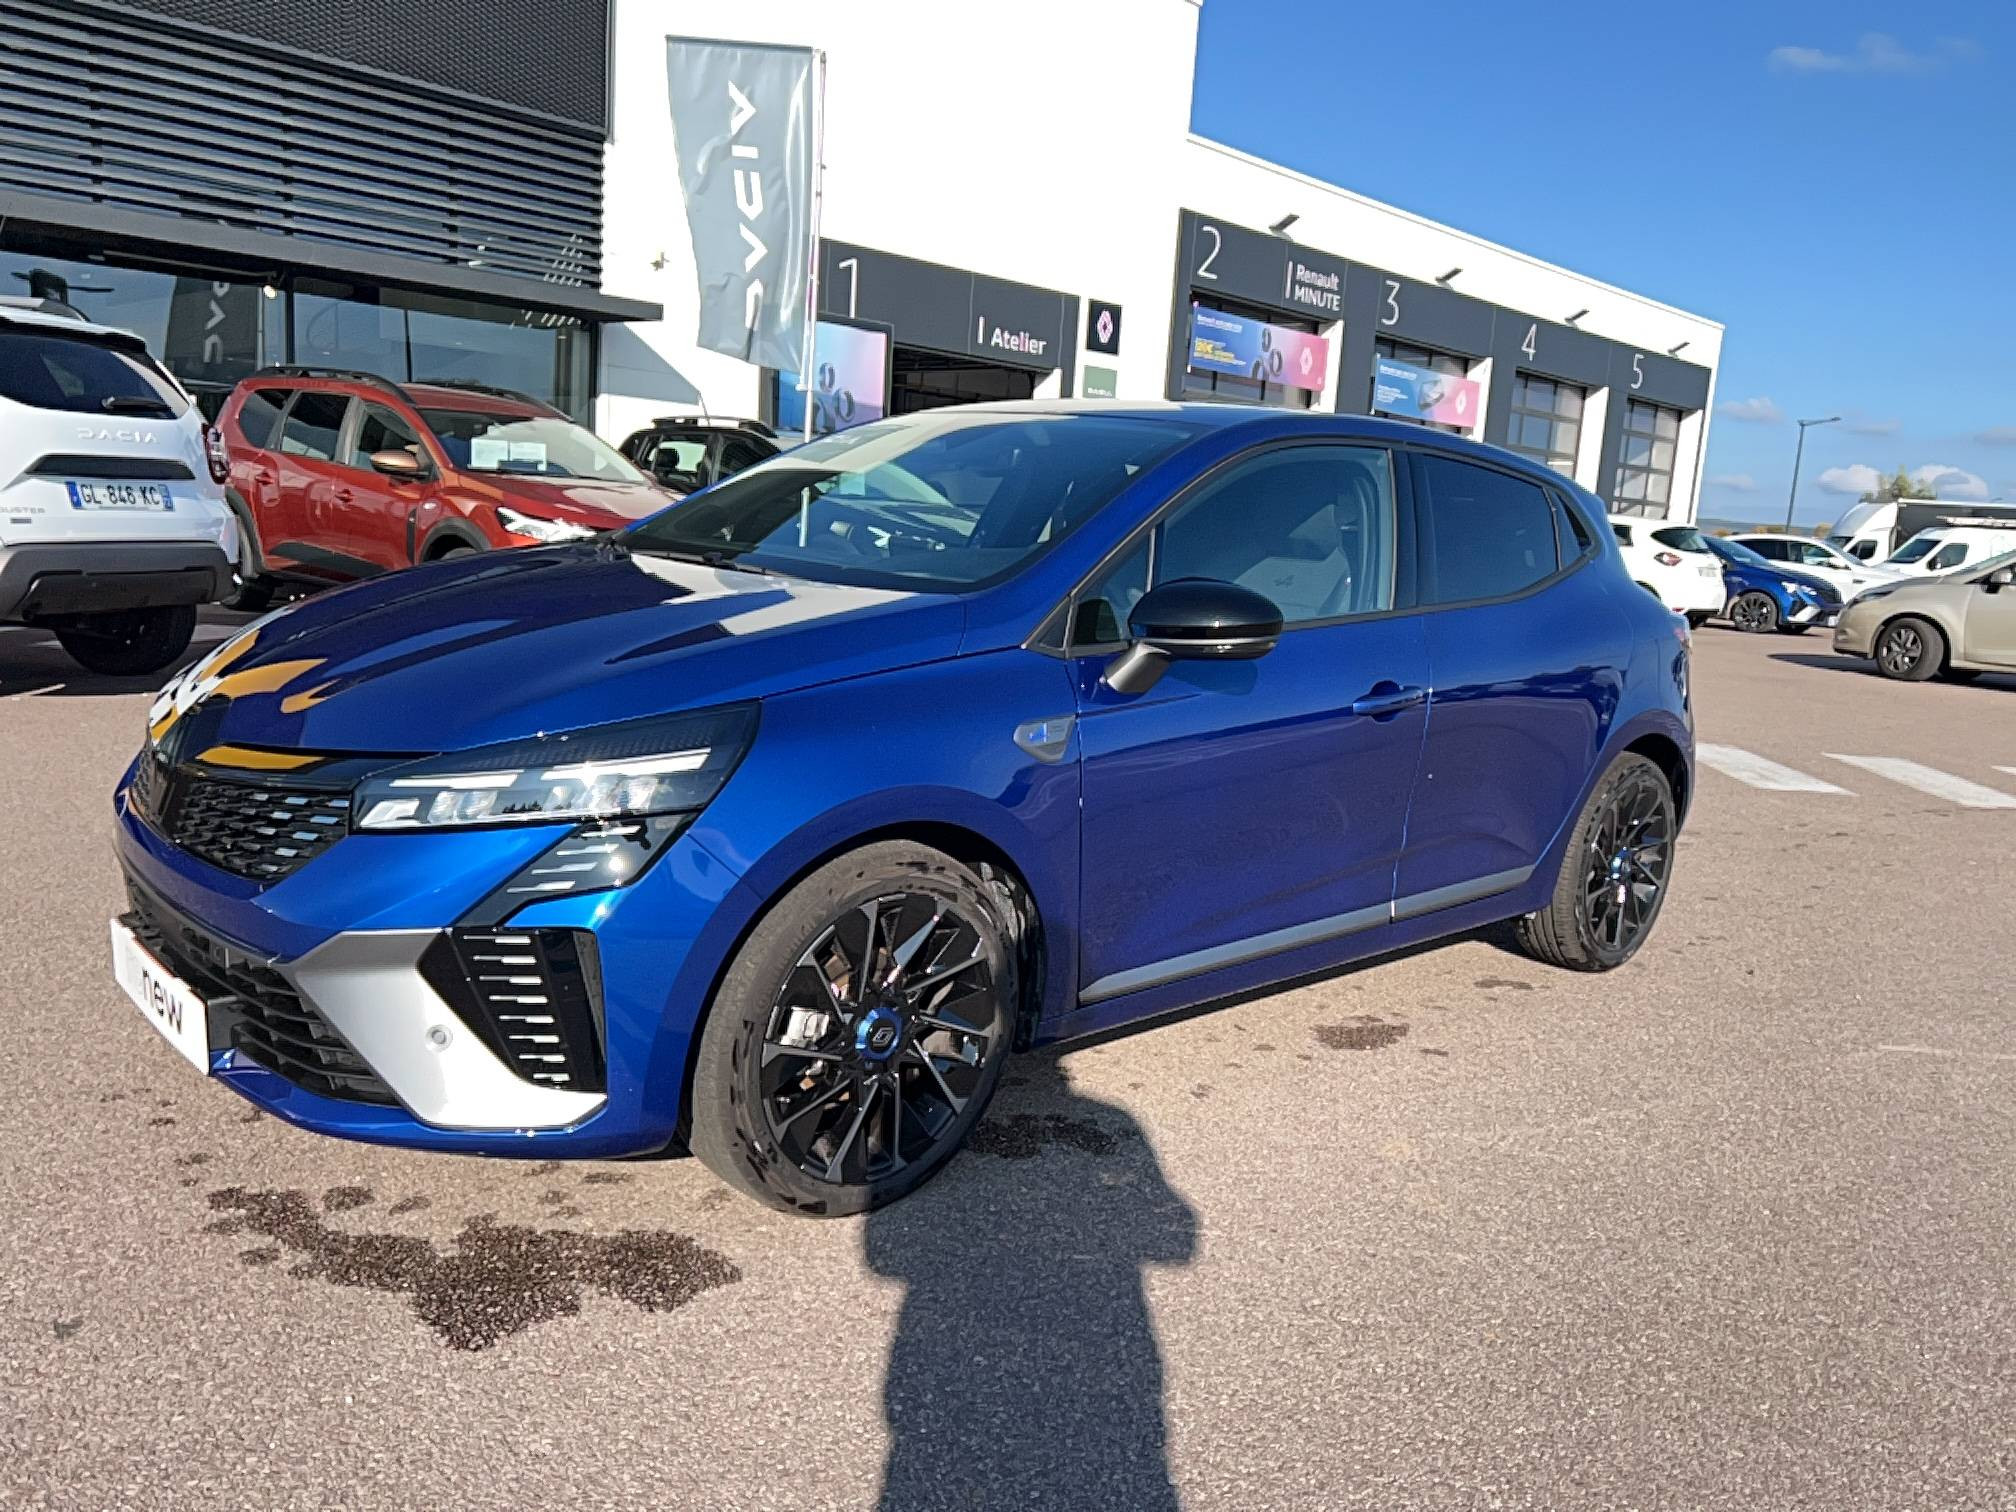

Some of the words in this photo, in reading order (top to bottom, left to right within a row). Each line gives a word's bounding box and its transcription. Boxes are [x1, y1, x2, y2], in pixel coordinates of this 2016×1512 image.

[1197, 225, 1222, 280] 2
[839, 257, 858, 320] 1
[1296, 263, 1340, 291] Renault
[1294, 285, 1341, 312] MINUTE
[1381, 279, 1401, 326] 3
[991, 327, 1047, 355] Atelier
[1520, 323, 1538, 362] 4
[1630, 353, 1645, 390] 5
[76, 427, 159, 444] DACIA
